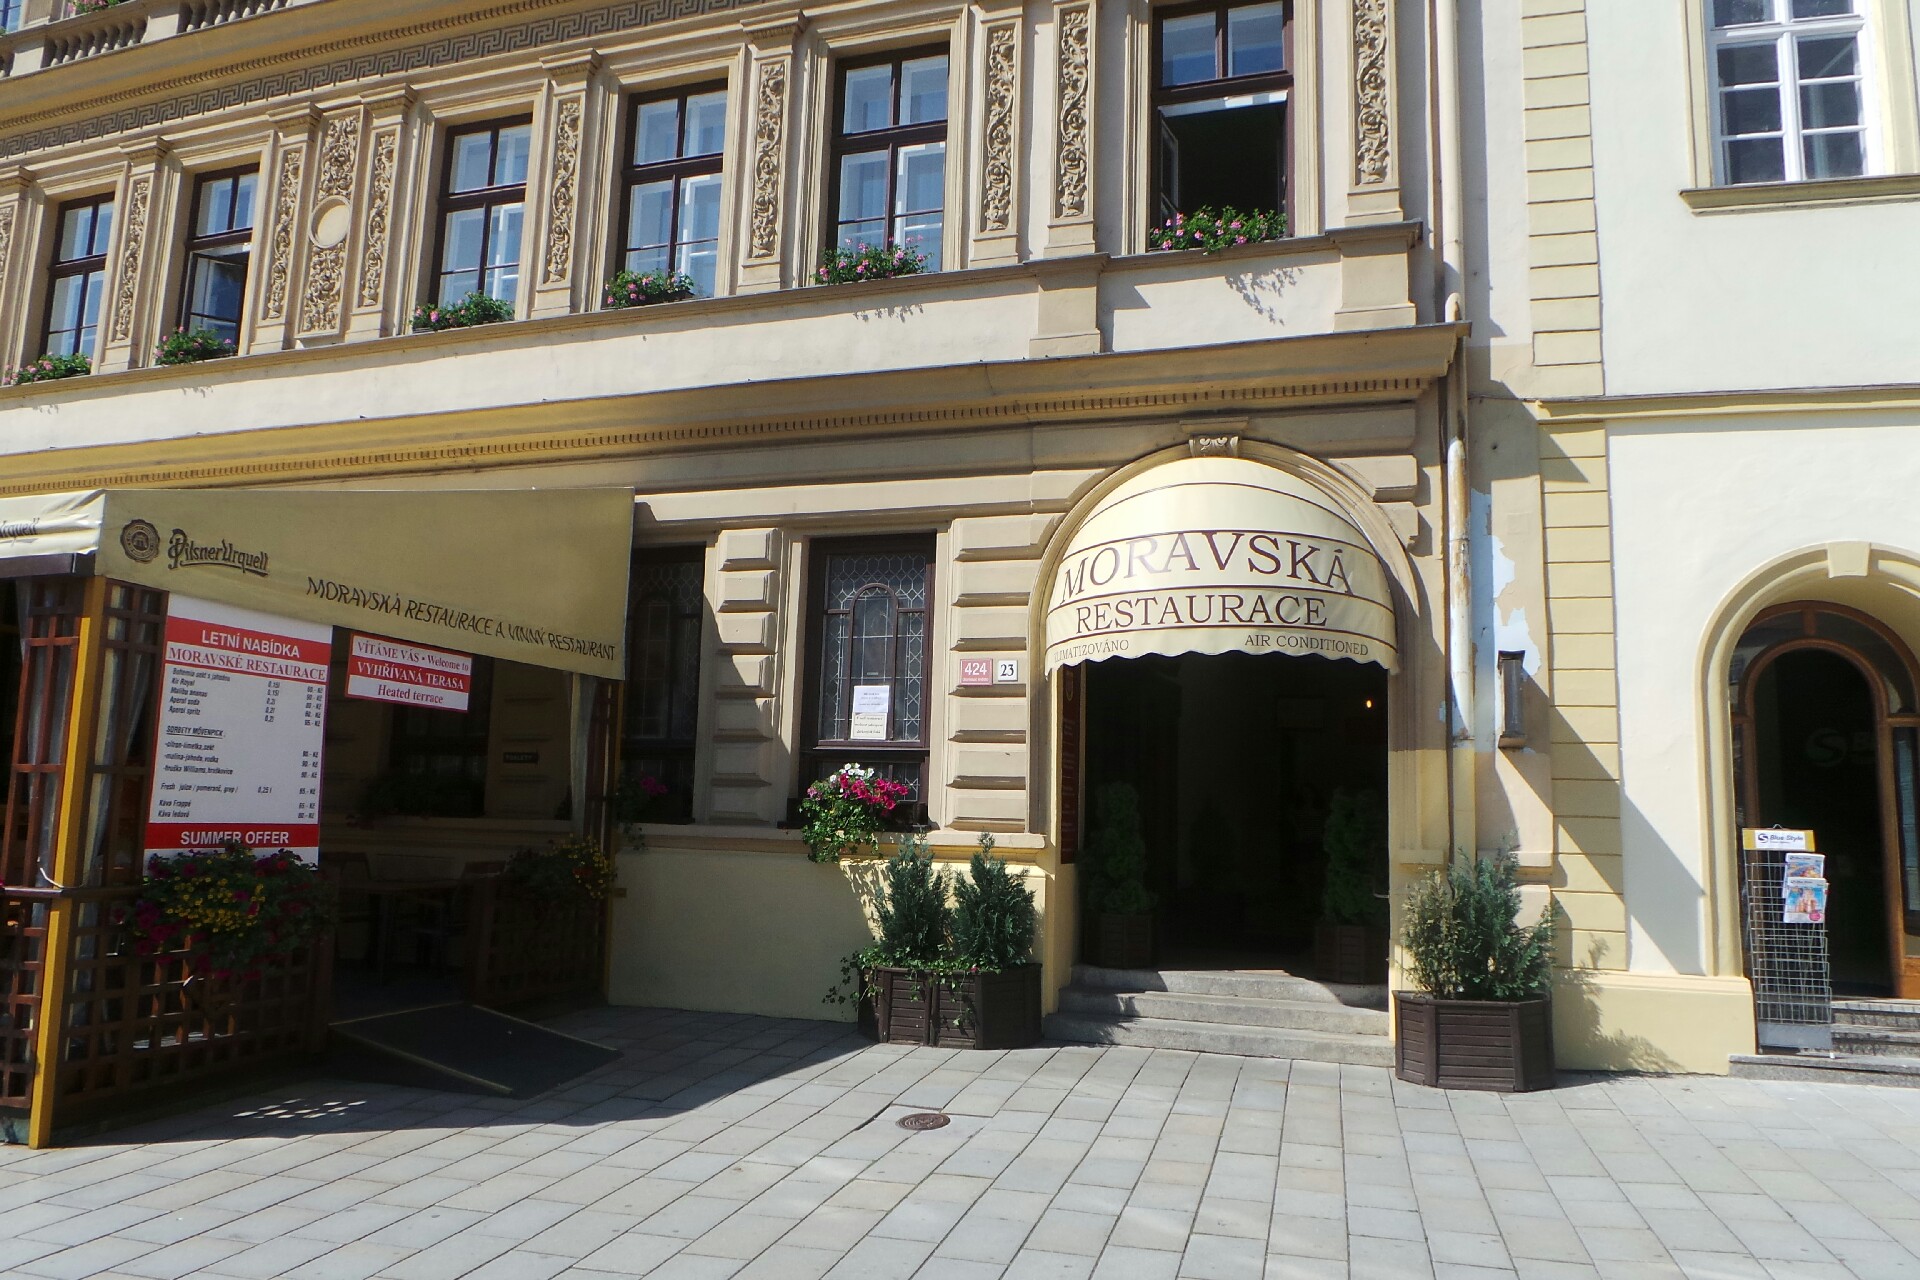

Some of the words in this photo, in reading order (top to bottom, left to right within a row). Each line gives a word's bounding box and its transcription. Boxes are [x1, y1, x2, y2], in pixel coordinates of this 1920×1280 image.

[168, 528, 223, 569] Pilsner
[221, 538, 269, 574] Urquell
[1060, 530, 1355, 605] MORAVSKÁ
[306, 576, 402, 613] MORAVSKÁ
[404, 599, 493, 636] RESTAURACE
[495, 621, 504, 637] A
[508, 623, 545, 645] VINNÝ
[547, 632, 616, 661] RESTAURANT
[1076, 594, 1328, 635] RESTAURACE
[202, 629, 240, 648] LETNÍ
[243, 637, 300, 658] NABÍDKA
[357, 640, 399, 659] VÍTÁME
[400, 647, 420, 663] VÁS
[427, 653, 460, 671] Welcome
[462, 662, 469, 671] to
[1244, 633, 1271, 649] AIR
[1275, 635, 1369, 656] CONDITIONED
[168, 647, 243, 668] MORAVSKÉ
[246, 659, 326, 680] RESTAURACE
[357, 661, 423, 683] VYHŘÍVANÁ
[425, 673, 464, 690] TERASA
[965, 662, 987, 676] 424
[1000, 664, 1014, 676] 23
[377, 684, 411, 700] Heated
[413, 692, 444, 705] terrace
[180, 831, 242, 845] SUMMER
[245, 831, 289, 844] OFFER
